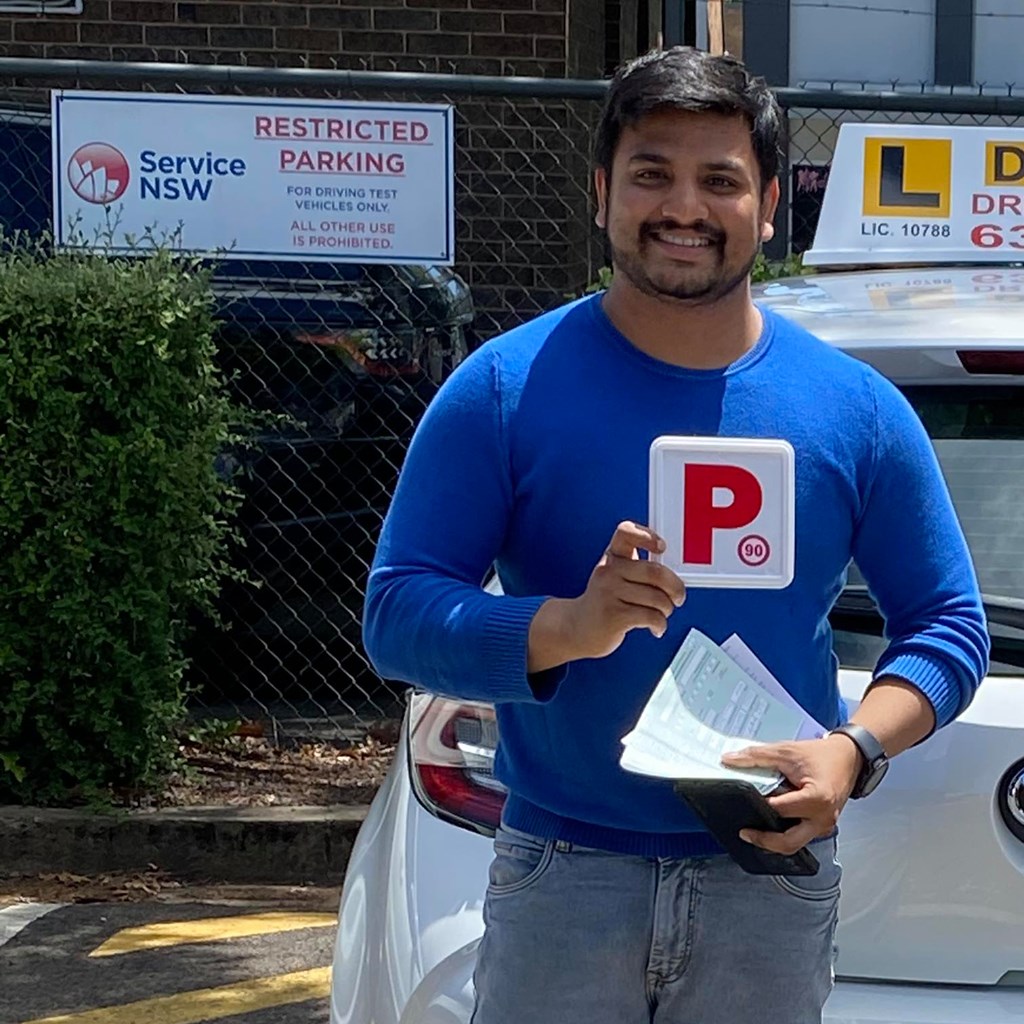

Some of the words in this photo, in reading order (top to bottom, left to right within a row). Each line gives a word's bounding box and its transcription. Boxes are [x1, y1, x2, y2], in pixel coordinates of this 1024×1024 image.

[254, 116, 429, 142] RESTRICTED
[140, 150, 246, 177] Service
[279, 149, 405, 174] PARKING
[878, 145, 941, 207] L
[140, 177, 213, 201] NSW
[287, 186, 312, 198] FOR
[315, 186, 366, 199] DRIVING
[369, 188, 398, 200] TEST
[295, 200, 354, 212] VEHICLES
[357, 201, 390, 213] ONLY.
[290, 221, 317, 233] ALL
[320, 221, 367, 234] OTHER
[369, 222, 396, 234] USE
[861, 222, 895, 237] LIC.
[901, 222, 951, 238] 10788
[293, 235, 306, 247] IS
[309, 236, 394, 250] PROHIBITED.
[682, 463, 763, 565] P
[744, 543, 763, 558] 90
